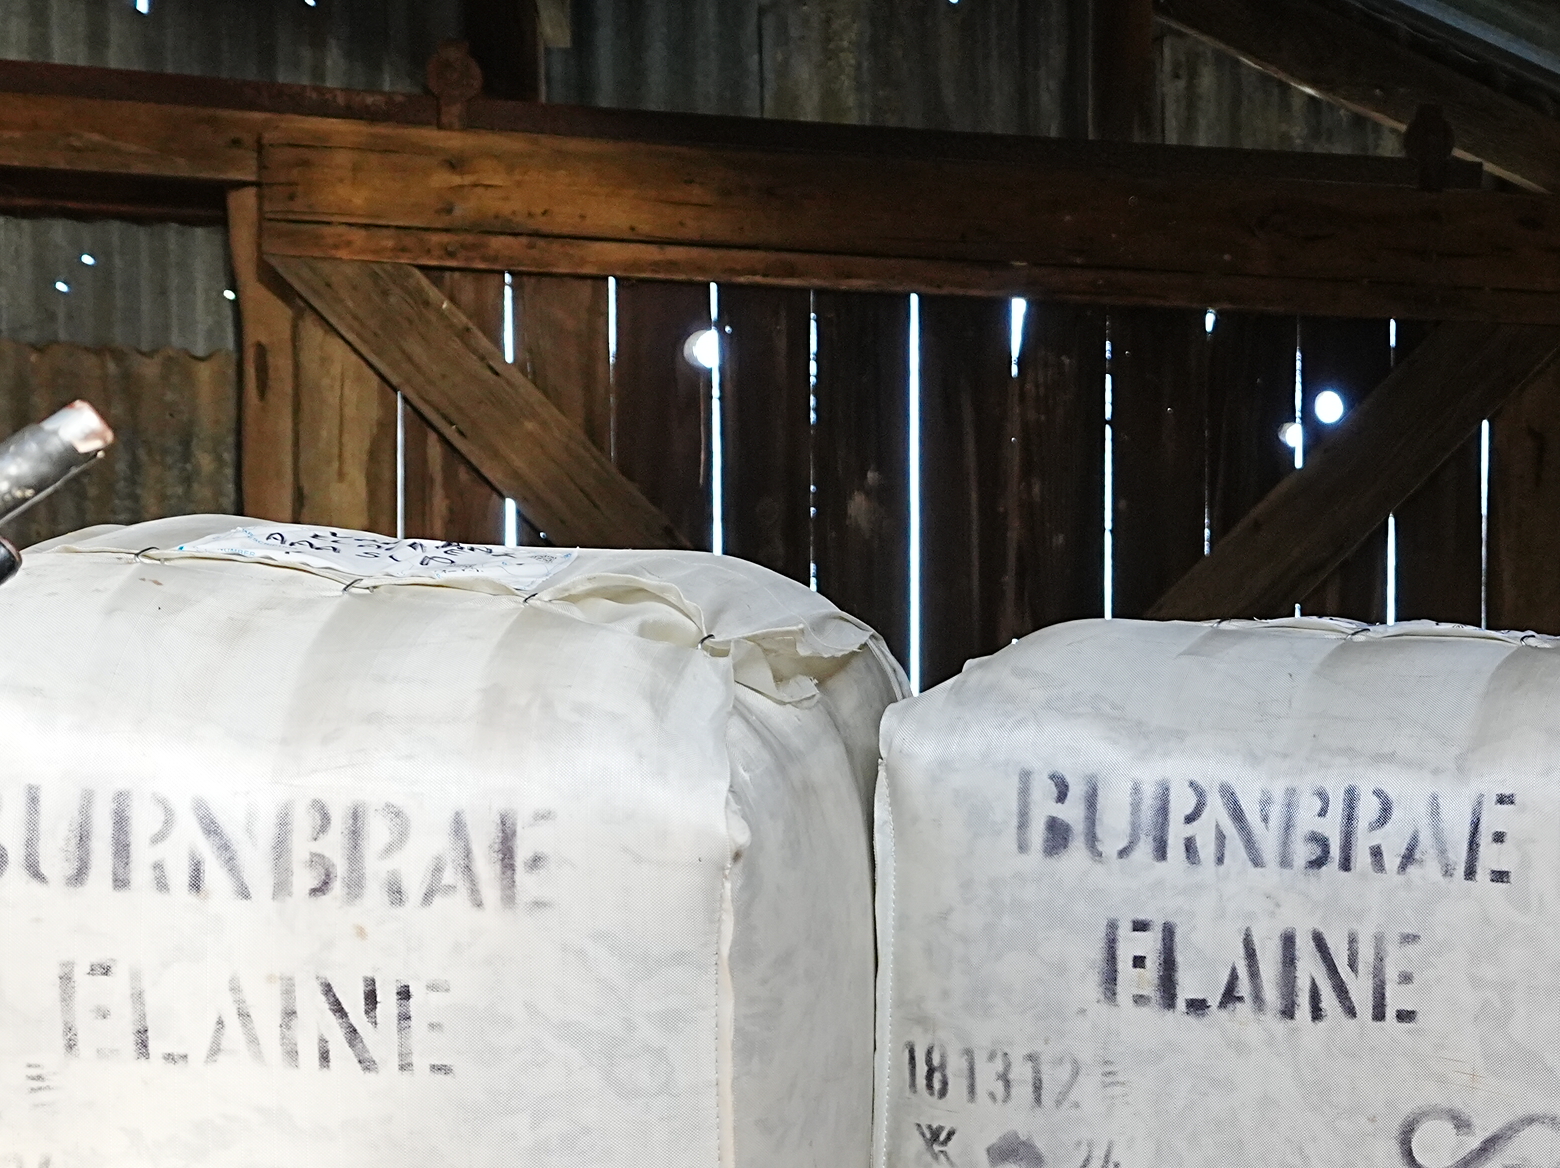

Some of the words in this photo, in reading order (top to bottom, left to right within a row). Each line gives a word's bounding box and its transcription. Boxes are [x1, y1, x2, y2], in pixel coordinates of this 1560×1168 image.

[1016, 767, 1516, 884] BURNBRAE
[58, 957, 456, 1076] ELAINE
[1099, 917, 1421, 1025] ELAINE
[904, 1040, 1081, 1110] 181312
